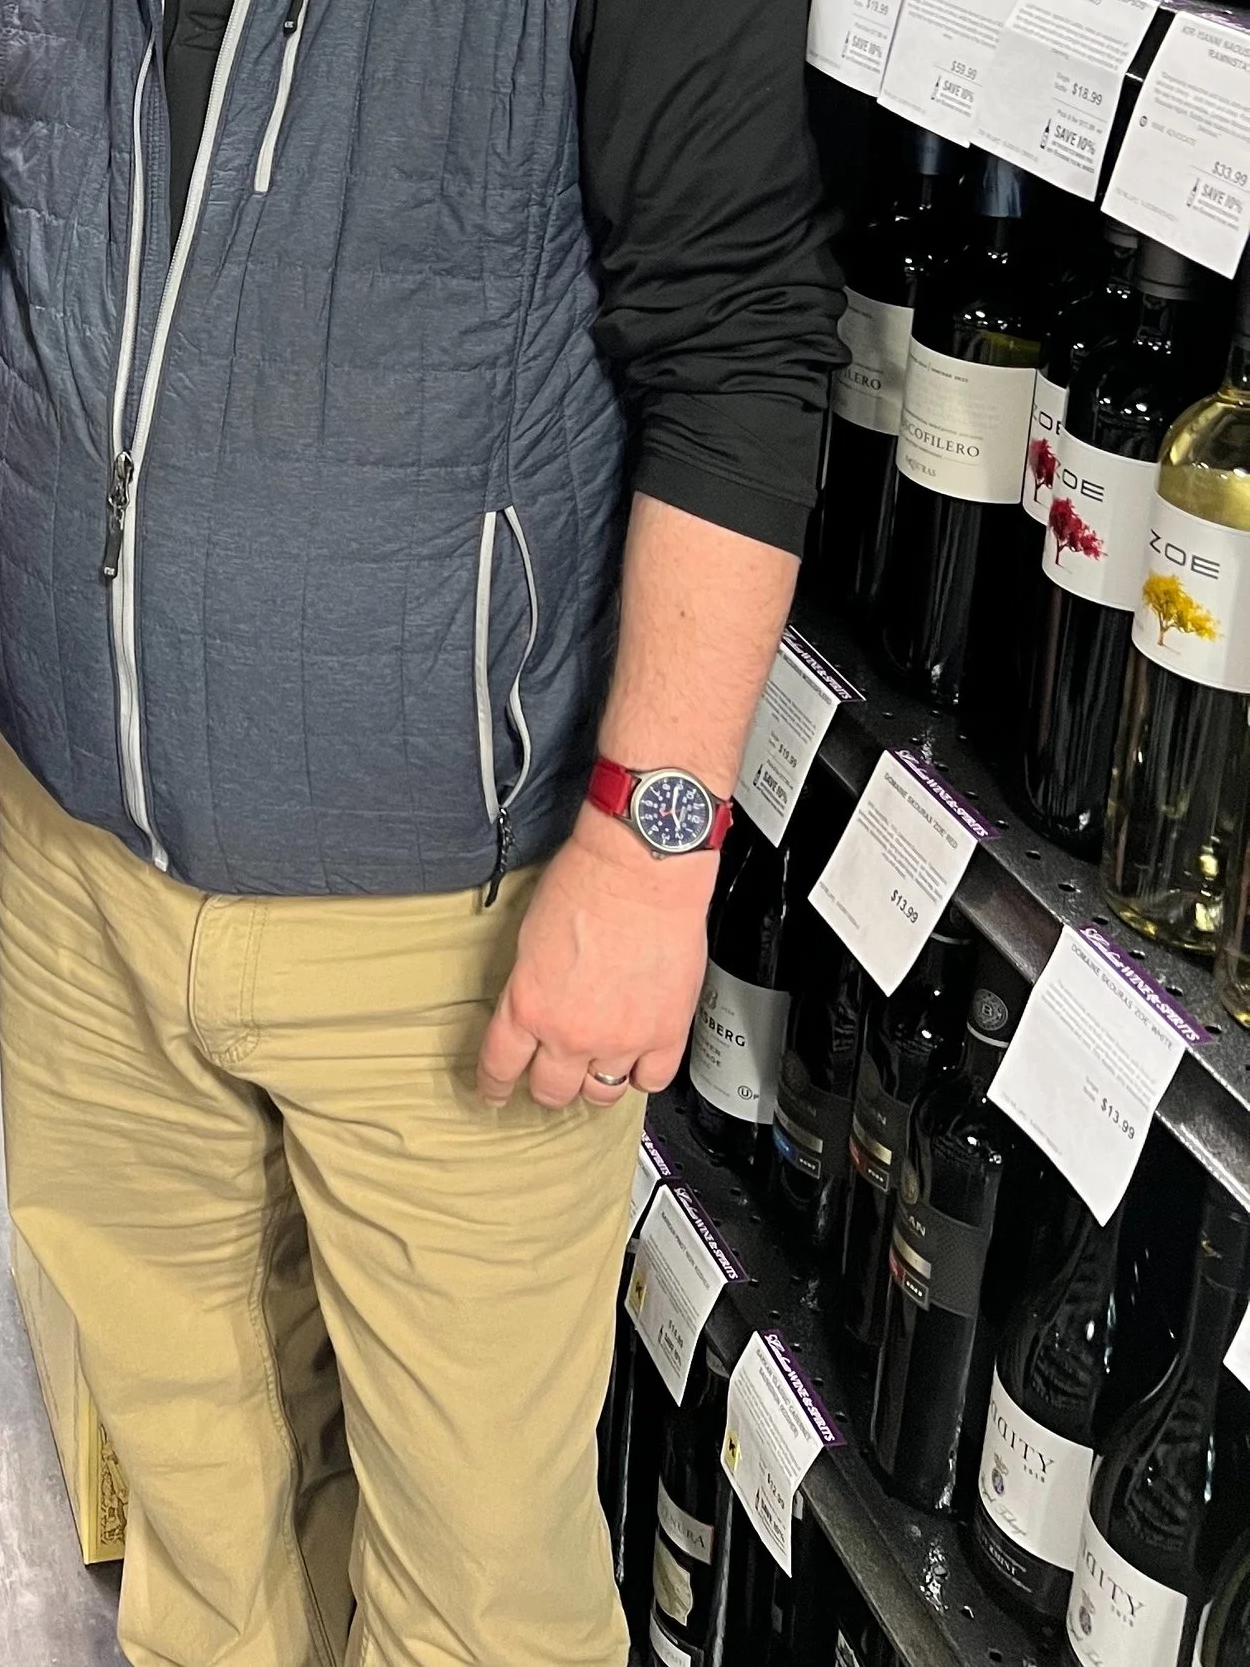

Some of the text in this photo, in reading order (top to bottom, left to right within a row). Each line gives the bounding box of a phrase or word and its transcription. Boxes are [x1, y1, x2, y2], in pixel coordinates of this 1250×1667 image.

[1072, 82, 1102, 106] $18.99
[1054, 124, 1096, 155] SAVE 10%
[1211, 160, 1248, 187] $33.99
[1201, 183, 1226, 206] SAVE
[1150, 528, 1221, 581] ZOE
[890, 889, 919, 924] $13.99
[1100, 1097, 1136, 1140] $13.99
